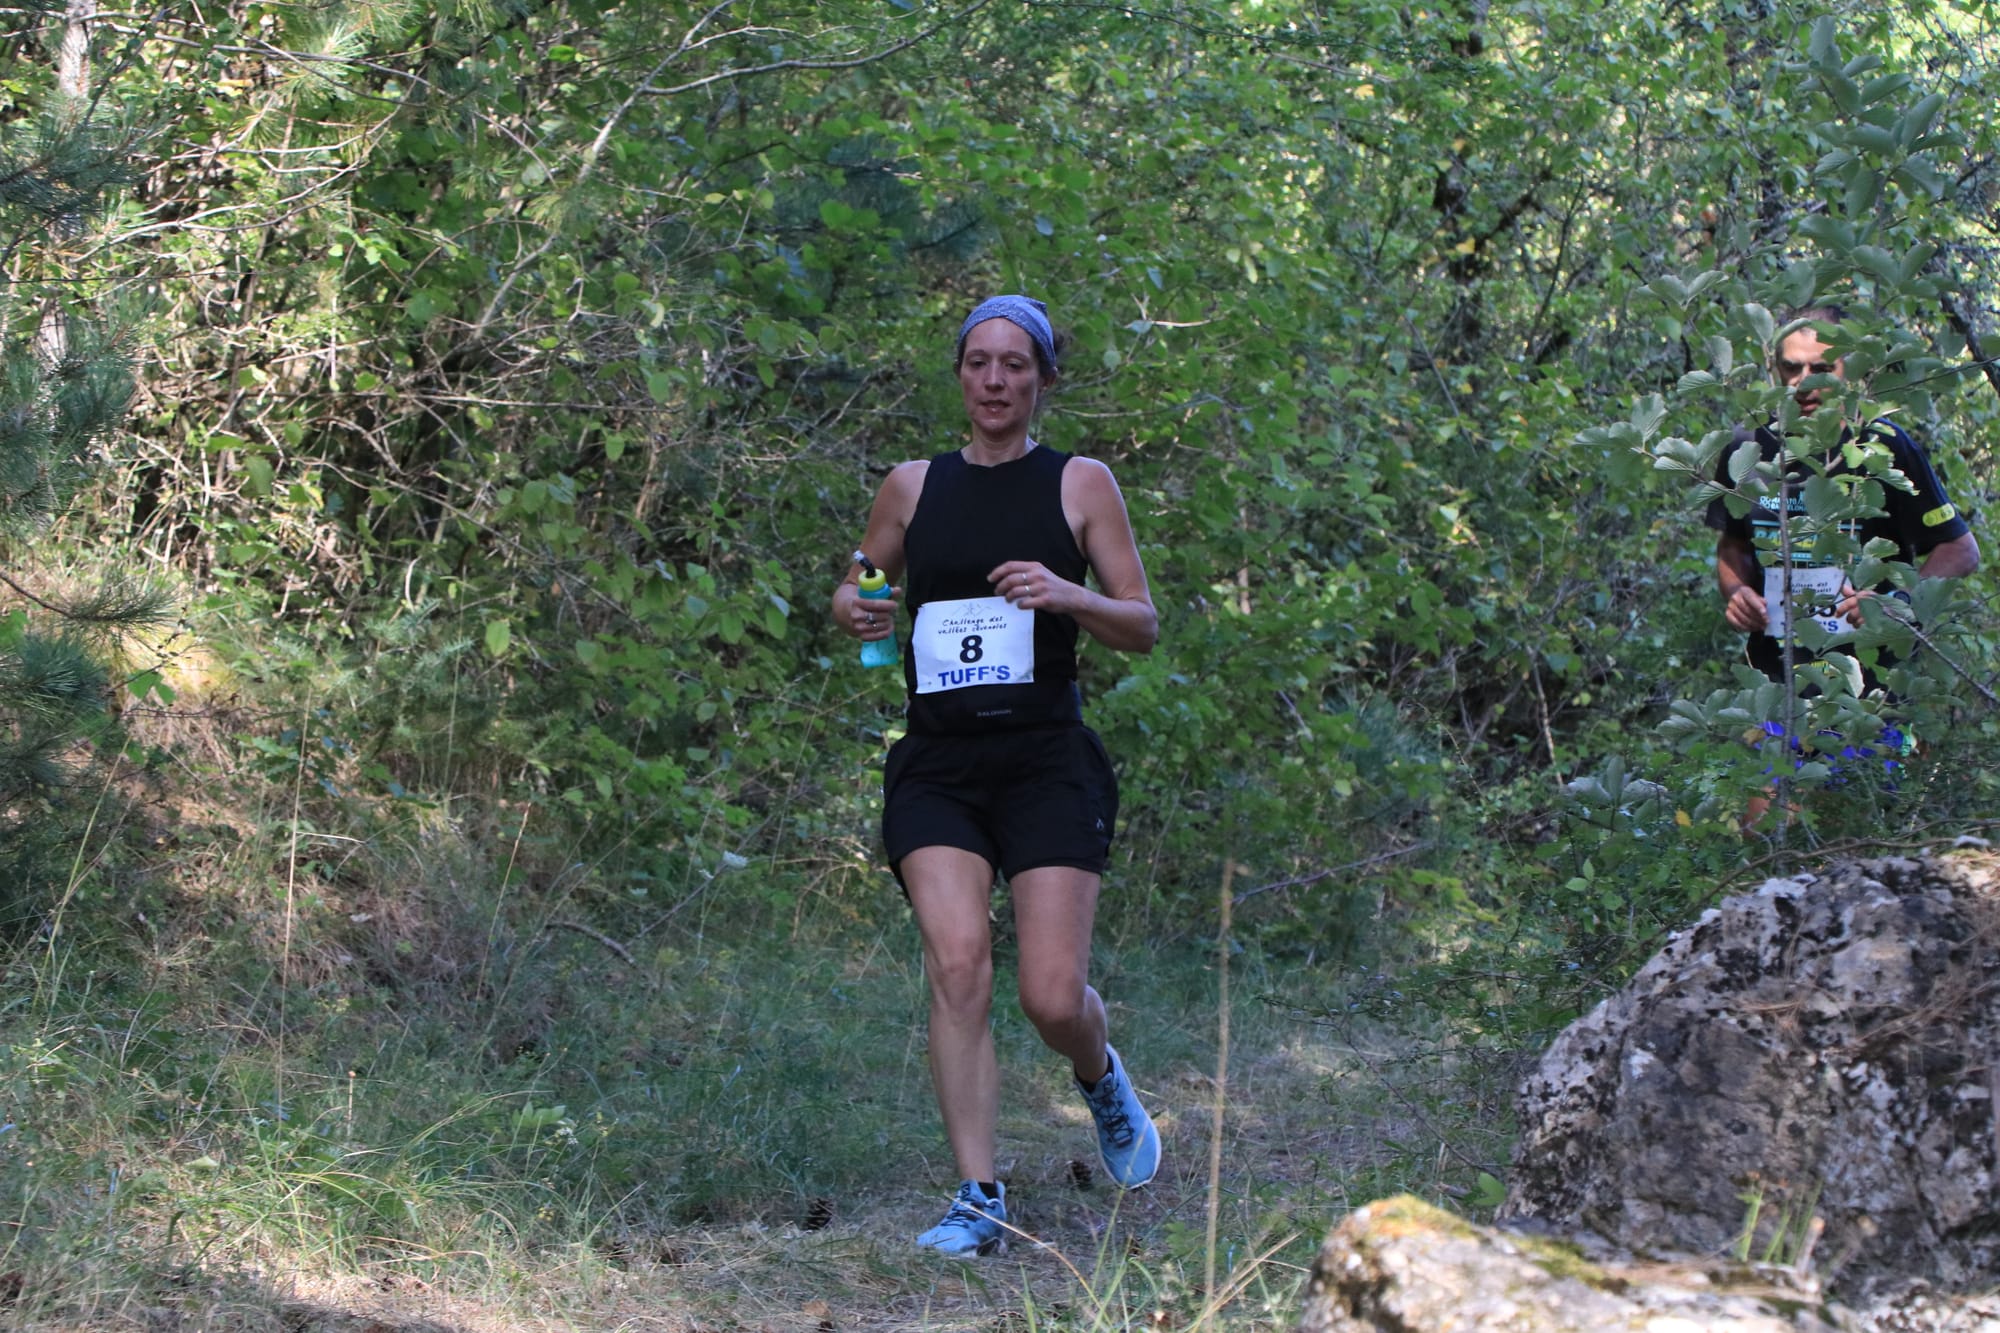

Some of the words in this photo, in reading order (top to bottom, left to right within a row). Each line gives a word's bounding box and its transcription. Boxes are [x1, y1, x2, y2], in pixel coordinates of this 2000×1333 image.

[943, 617, 984, 627] Challenge
[960, 634, 983, 663] 8
[938, 665, 1010, 687] TUFF'S
